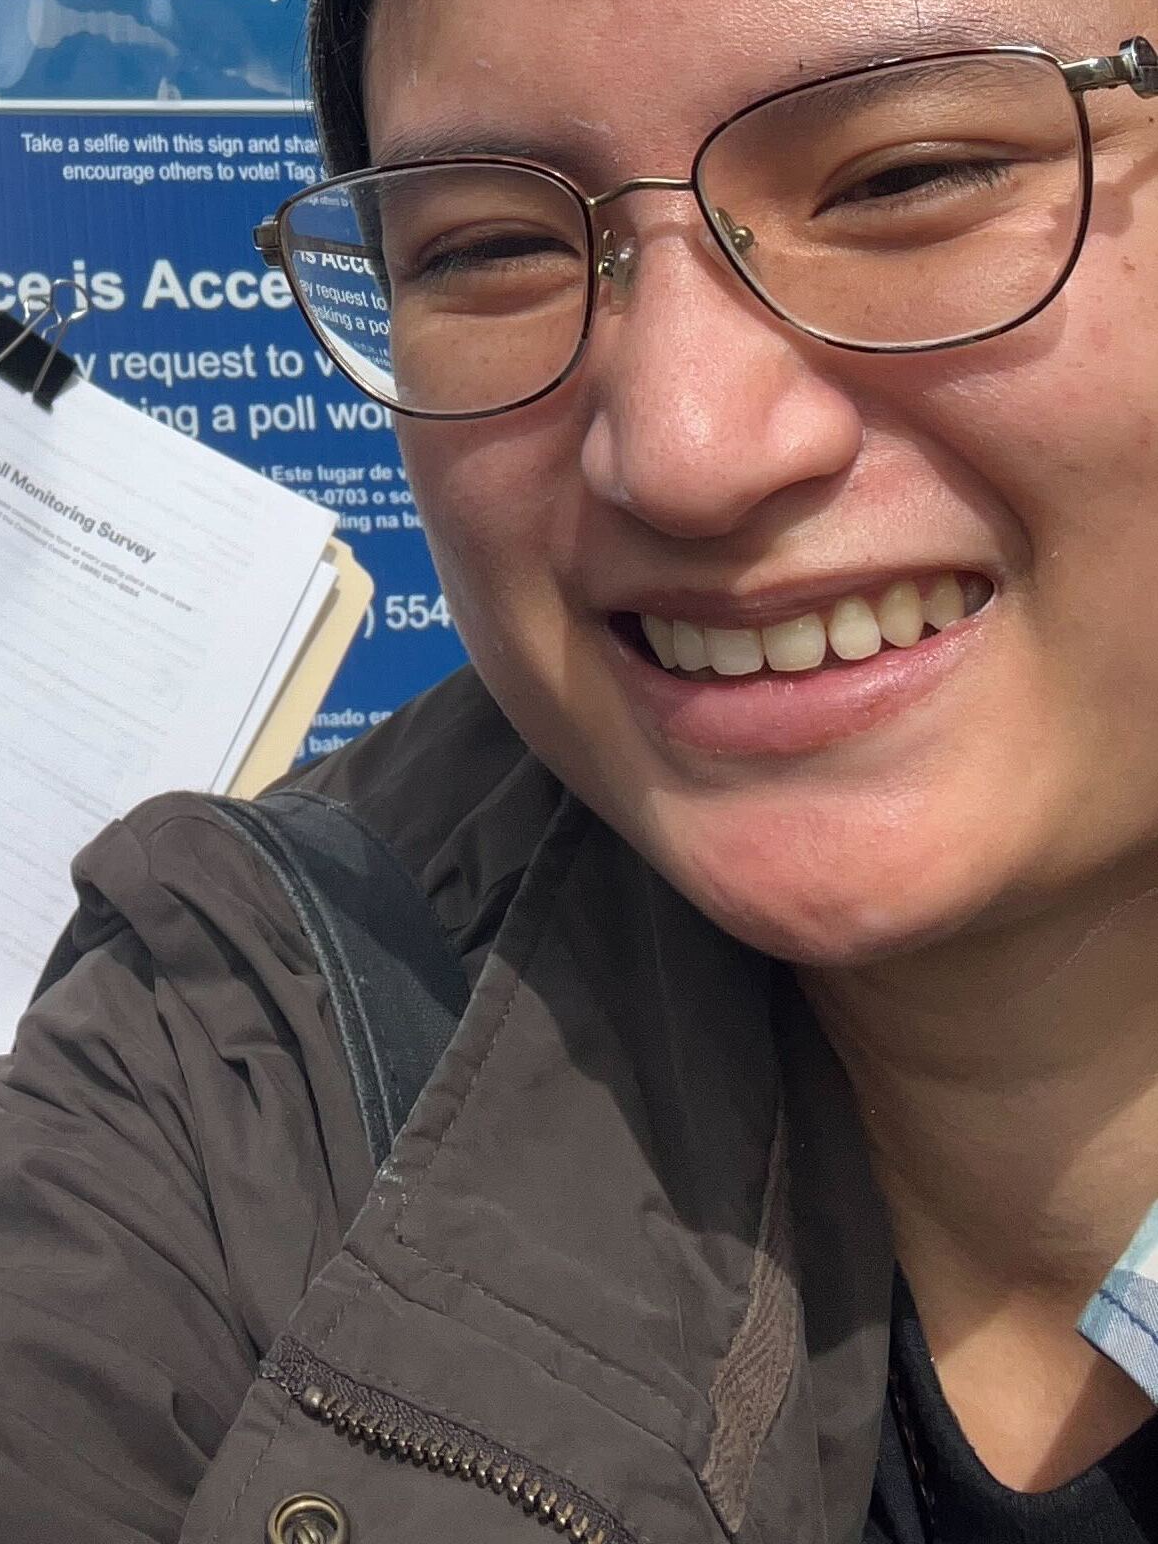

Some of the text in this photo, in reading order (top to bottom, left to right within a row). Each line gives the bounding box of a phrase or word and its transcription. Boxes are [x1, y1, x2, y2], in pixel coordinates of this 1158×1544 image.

[21, 133, 63, 153] Take
[68, 138, 80, 153] a
[84, 133, 130, 153] selfie
[133, 133, 169, 153] with
[173, 134, 203, 153] this
[208, 134, 243, 157] sign
[248, 134, 280, 153] and
[63, 165, 154, 185] encourage
[159, 162, 213, 180] others
[217, 162, 234, 180] to
[238, 162, 280, 180] vote!
[283, 161, 316, 184] Tag
[73, 259, 126, 311] is
[143, 259, 293, 310] Acce
[110, 344, 257, 388] request
[267, 344, 305, 378] to
[212, 404, 237, 432] a
[249, 395, 316, 440] poll
[271, 465, 313, 482] Este
[317, 464, 365, 485] lugar
[369, 464, 393, 481] de
[9, 468, 97, 534] Monitoring
[96, 521, 157, 564] Survey
